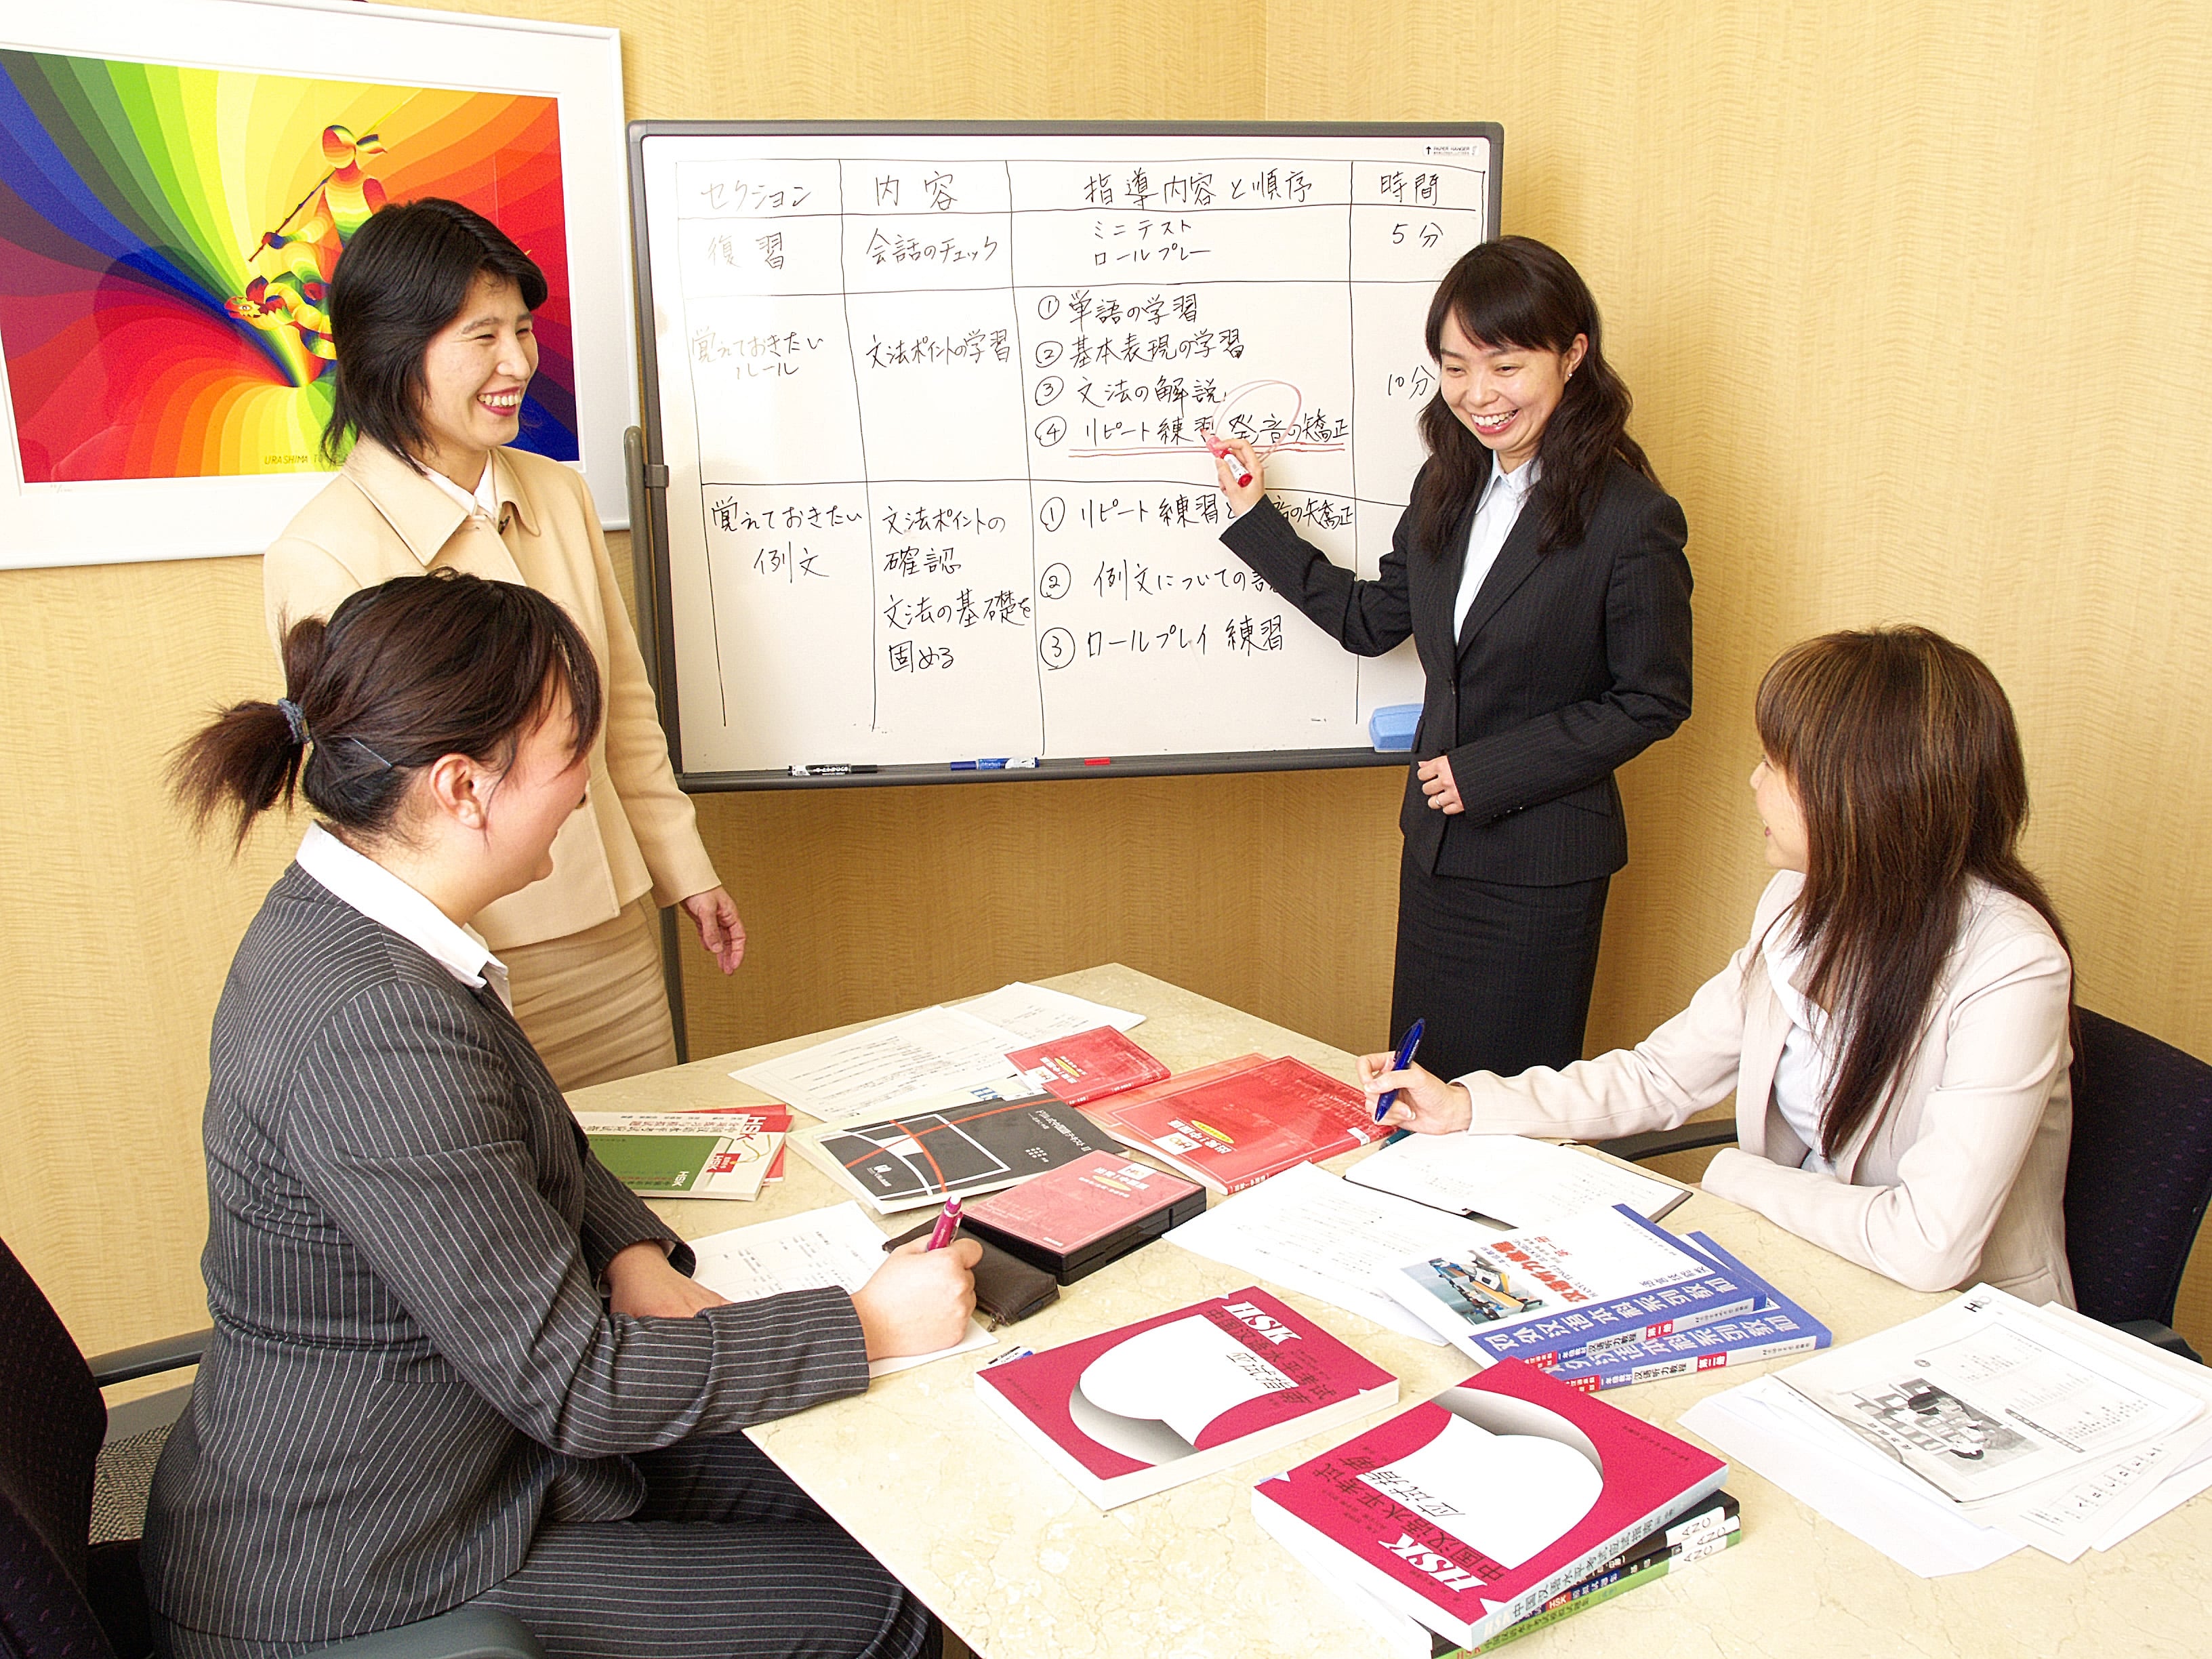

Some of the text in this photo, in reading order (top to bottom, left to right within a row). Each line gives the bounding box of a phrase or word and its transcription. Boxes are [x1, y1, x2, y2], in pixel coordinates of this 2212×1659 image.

[700, 180, 811, 211] セクション
[875, 170, 958, 210] 内容
[1084, 167, 1313, 209] 指導内容と順序
[1380, 172, 1440, 207] 時間
[865, 227, 999, 264] 会話のチェック
[1093, 219, 1193, 241] ミニテスト
[1391, 220, 1445, 249] 5分
[708, 231, 784, 270] 復習
[865, 328, 1012, 369] 文法ポイントの学習
[735, 363, 800, 381] ルール
[264, 455, 308, 465] URASHIMA
[711, 495, 865, 533] 覚えておきたい
[882, 505, 1006, 535] 文法ポイントの
[754, 540, 830, 583] 例文
[883, 546, 962, 578] 確認
[883, 588, 1032, 630] 文法の基礎を
[888, 639, 955, 673] 固める
[737, 1115, 767, 1141] HSK
[672, 1170, 690, 1187] HSK
[1221, 1300, 1303, 1346] HSK
[1378, 1532, 1490, 1596] HSK
[1548, 1594, 1568, 1610] HSK
